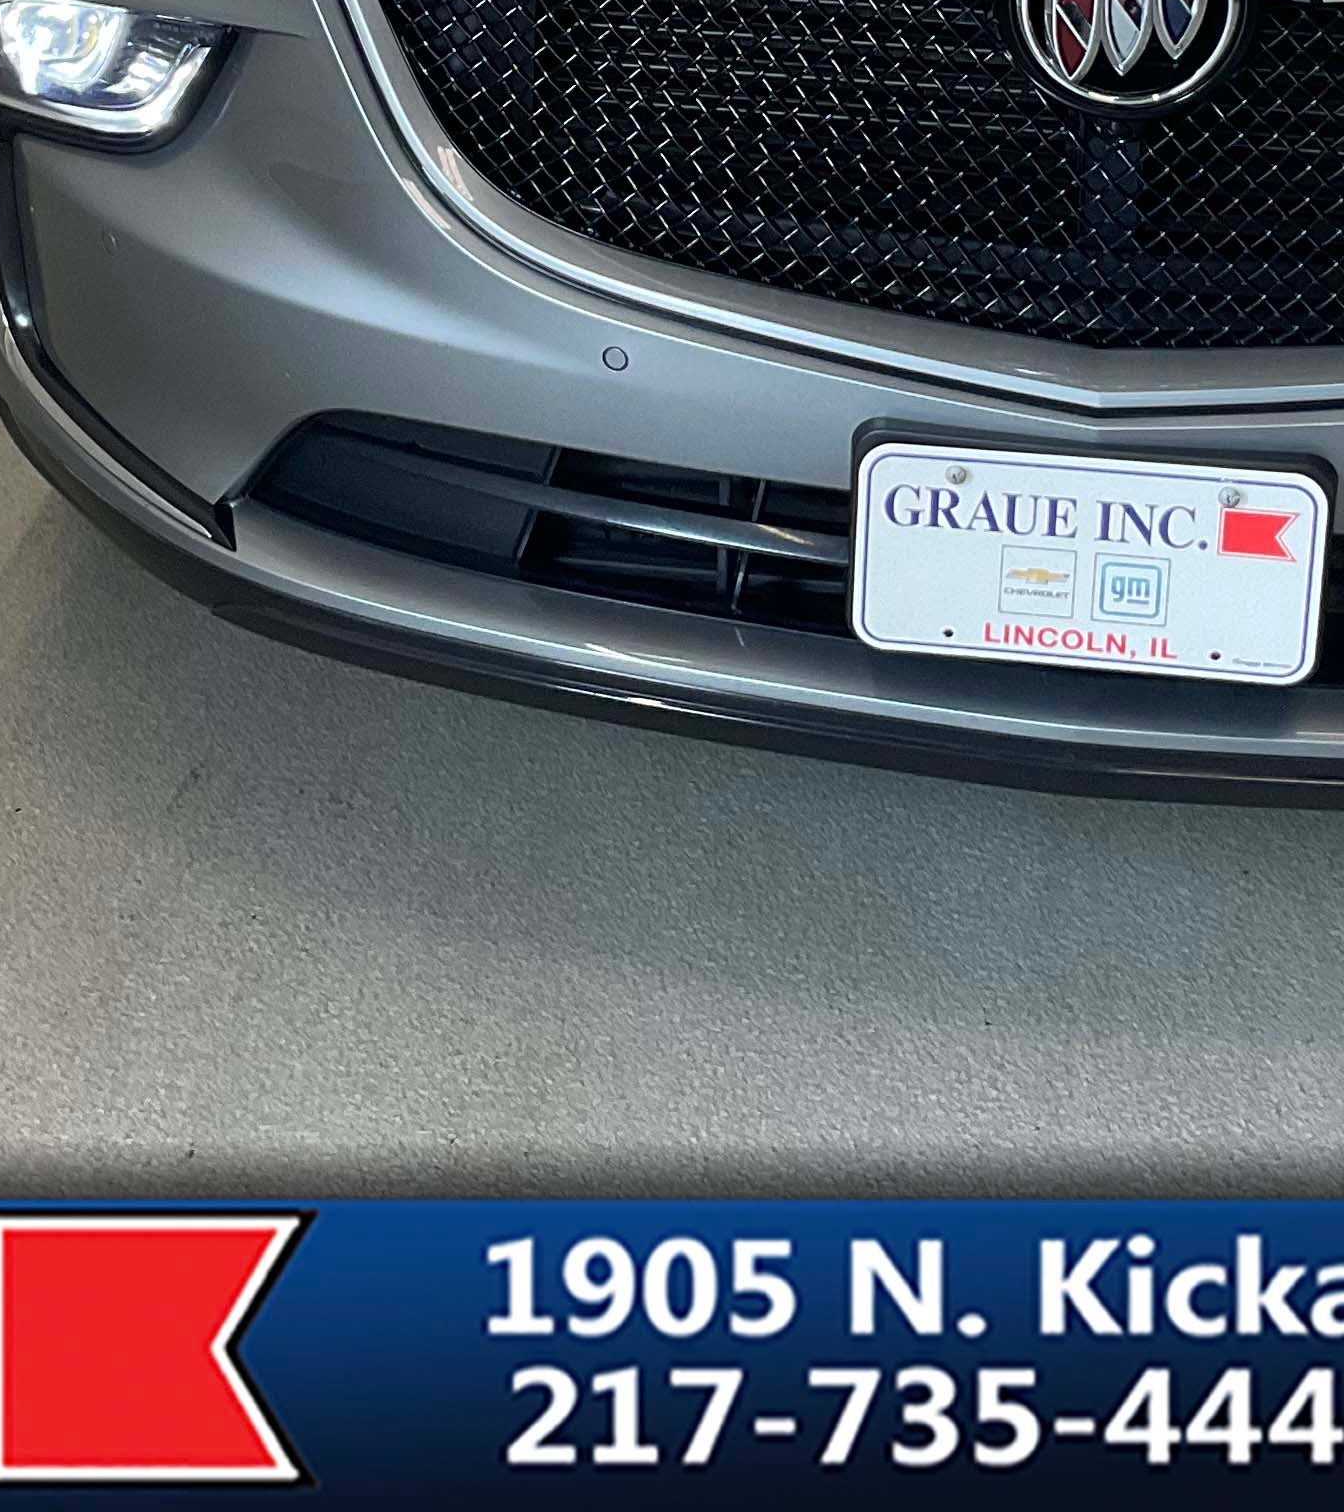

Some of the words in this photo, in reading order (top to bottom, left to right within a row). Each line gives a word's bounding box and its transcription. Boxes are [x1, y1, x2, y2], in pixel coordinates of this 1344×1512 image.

[883, 483, 1079, 539] GRAUE
[1093, 499, 1209, 552] INC.
[1003, 585, 1071, 601] CHEVROLET
[1110, 575, 1151, 606] gm
[982, 621, 1138, 660] LINCOLN,
[1150, 635, 1179, 660] IL
